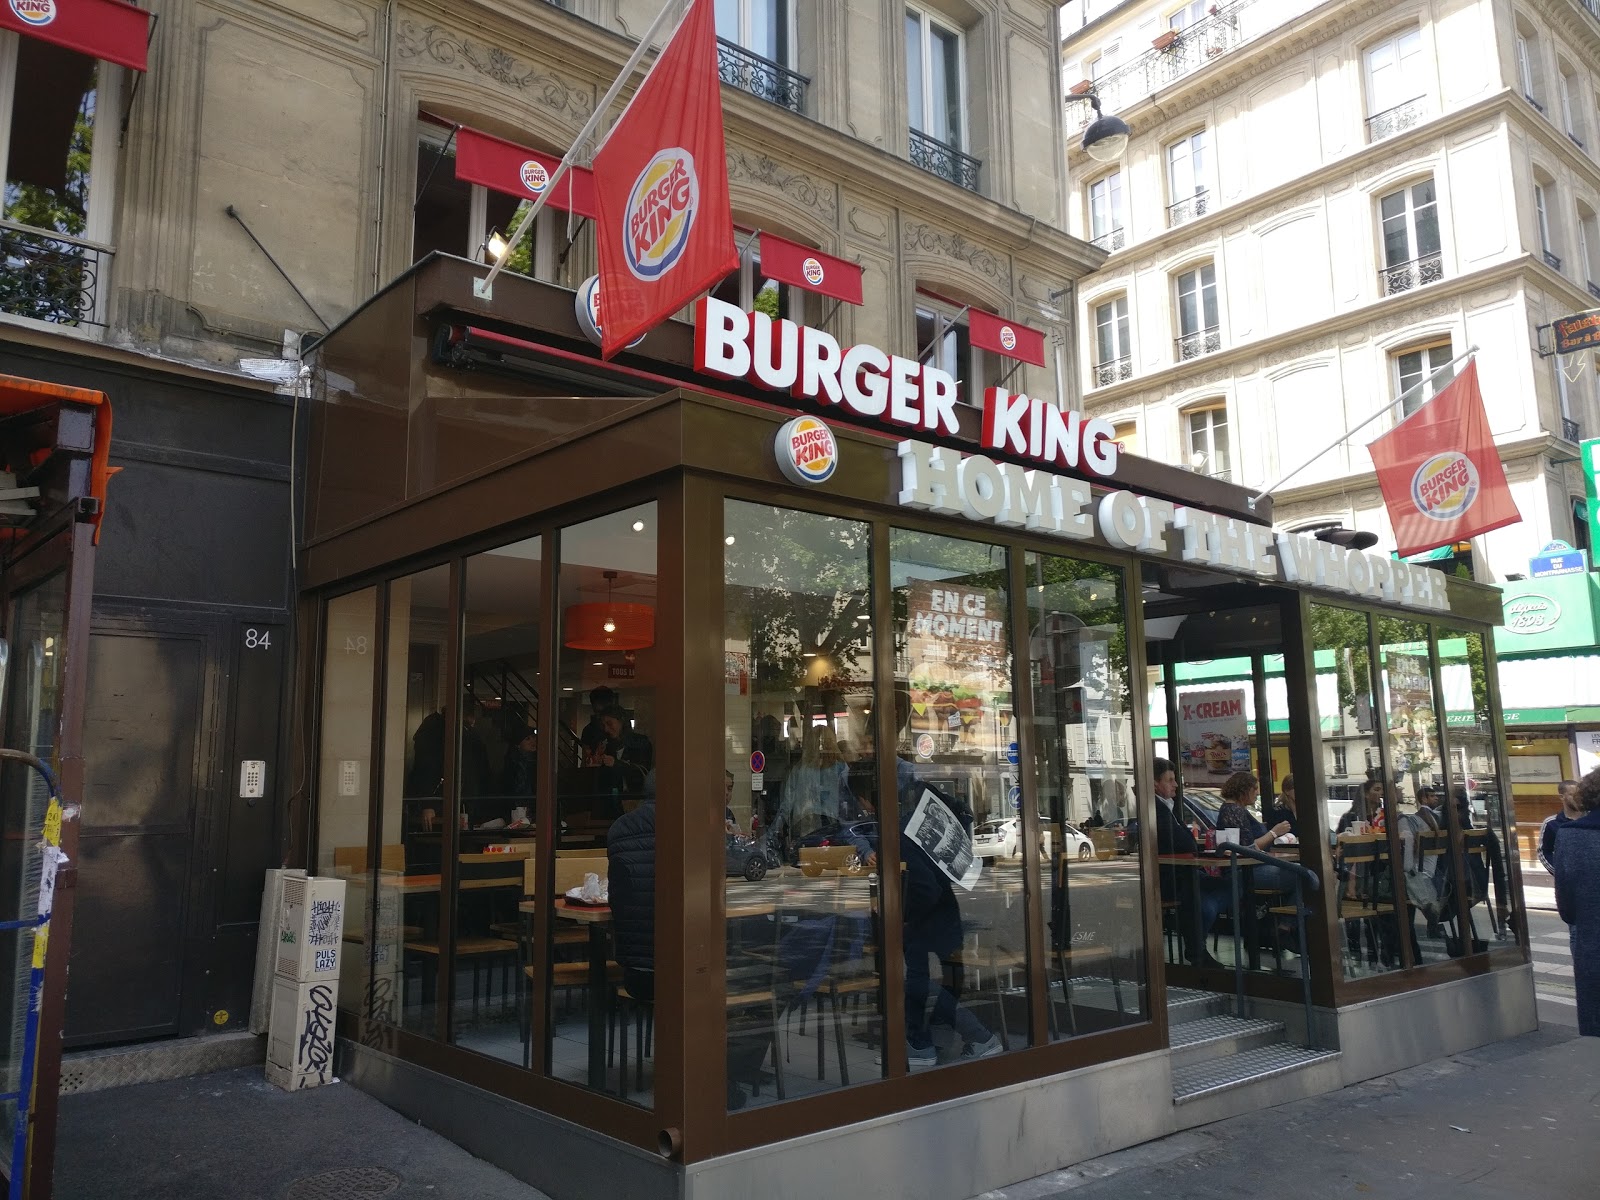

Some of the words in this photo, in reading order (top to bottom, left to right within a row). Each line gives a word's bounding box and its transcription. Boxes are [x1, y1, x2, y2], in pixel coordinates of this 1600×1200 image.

[16, 2, 51, 12] KING
[525, 174, 546, 182] KING
[632, 158, 687, 234] BURGER
[634, 177, 691, 267] KING
[696, 296, 960, 435] BURGER
[984, 387, 1118, 476] KING
[792, 429, 829, 450] BURGER
[795, 440, 833, 467] KING
[1420, 459, 1467, 497] BURGER
[1424, 468, 1470, 511] KING
[898, 439, 1094, 539] HOME
[1099, 489, 1175, 553] OF
[1174, 506, 1278, 576] THE
[1278, 532, 1452, 611] WHOPPER
[931, 589, 959, 613] EN
[962, 594, 986, 617] CE
[245, 628, 271, 650] 84
[914, 612, 1003, 642] MOMENT
[1182, 699, 1242, 720] X-CREAM
[315, 959, 336, 969] LAZY
[316, 949, 336, 960] PULS
